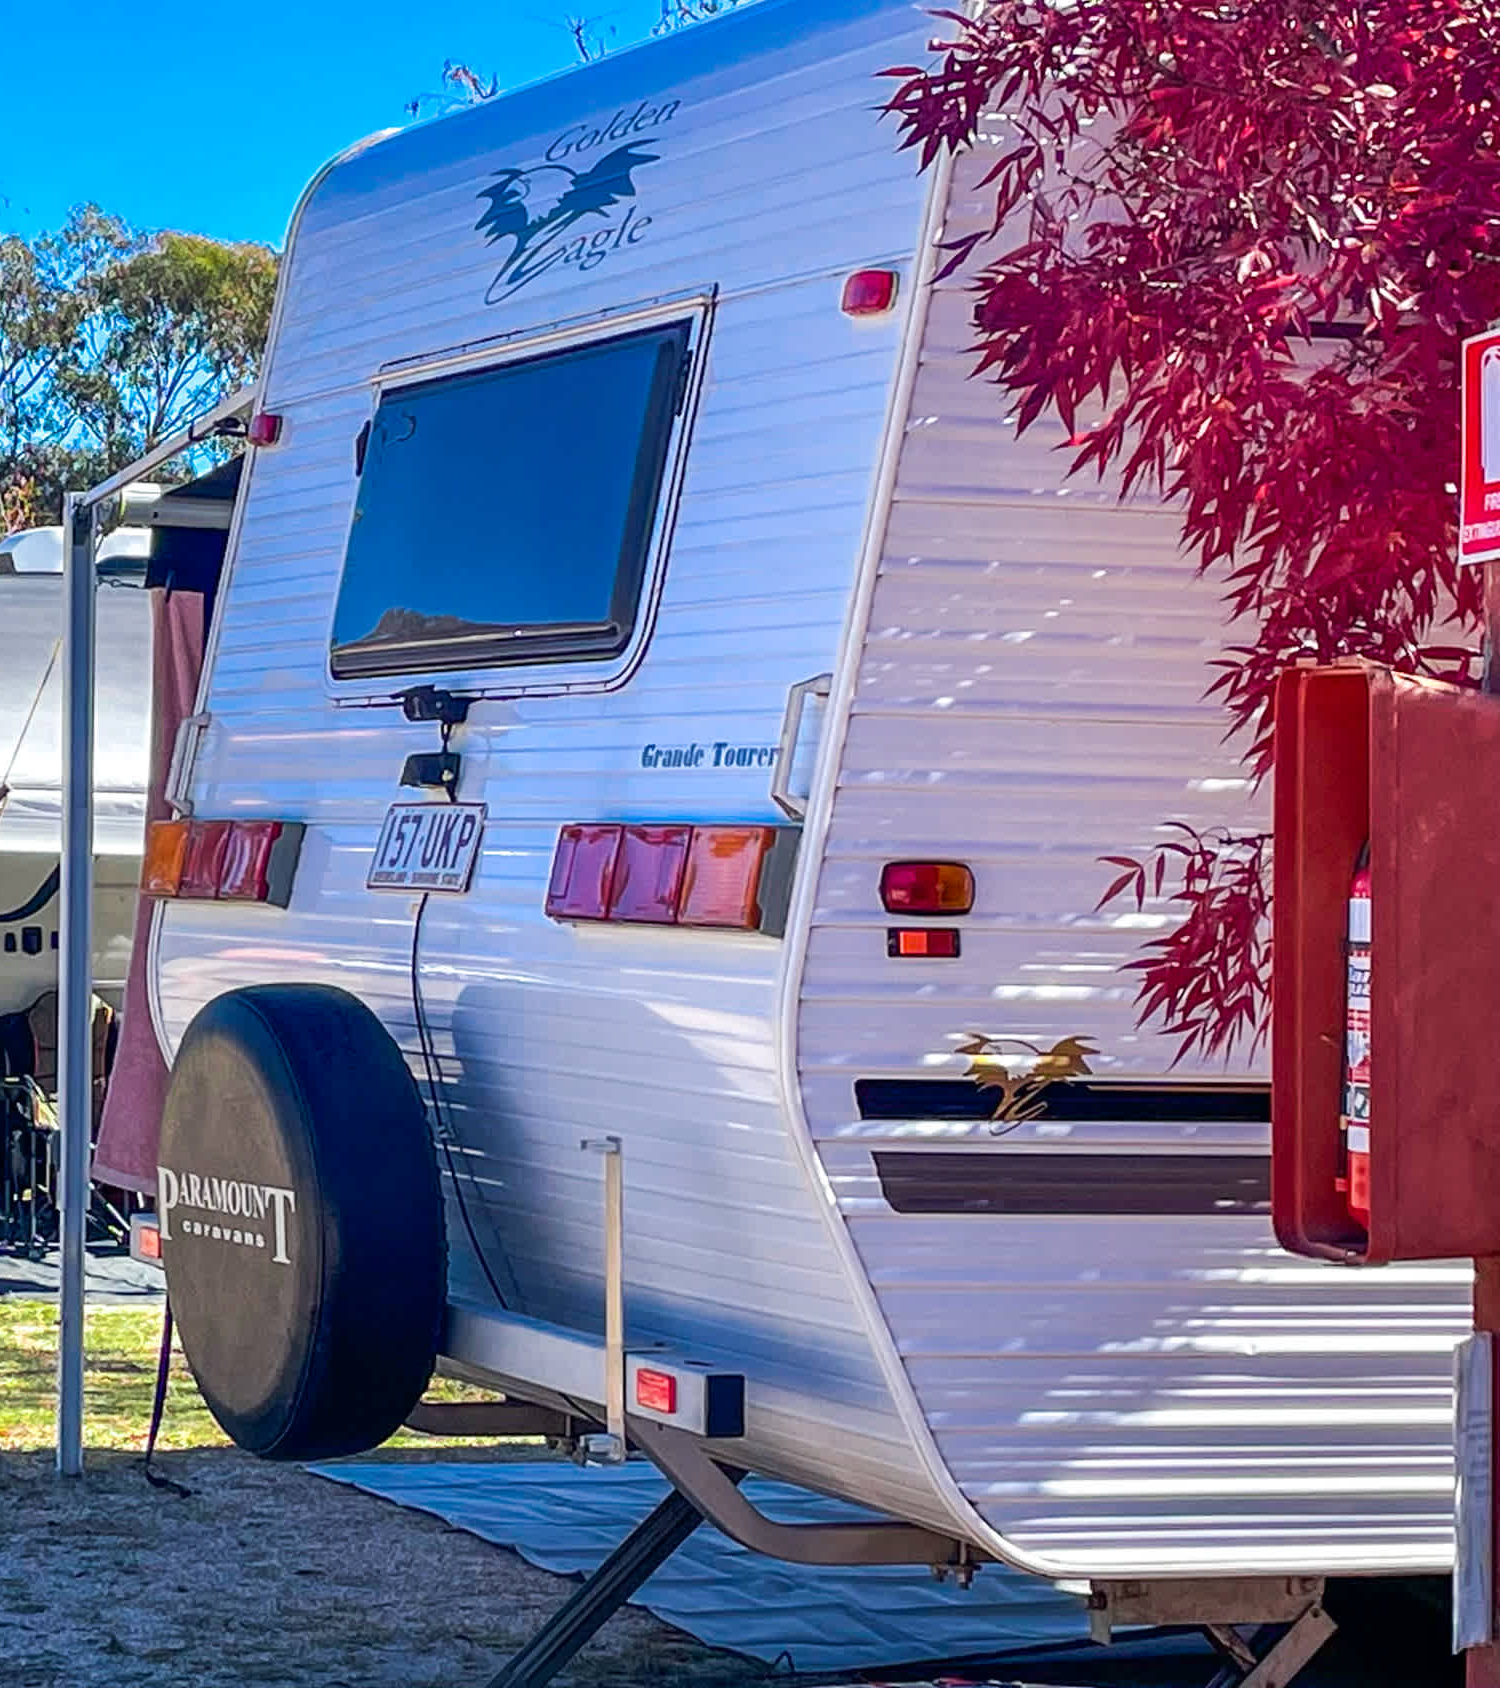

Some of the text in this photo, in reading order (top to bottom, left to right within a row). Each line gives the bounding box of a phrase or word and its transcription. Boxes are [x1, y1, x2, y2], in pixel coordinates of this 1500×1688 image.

[545, 98, 681, 162] Golden
[484, 206, 653, 306] Eagle
[641, 741, 784, 768] Grande Tourer
[157, 1166, 295, 1264] PARAMOUNT
[182, 1220, 265, 1248] caravans
